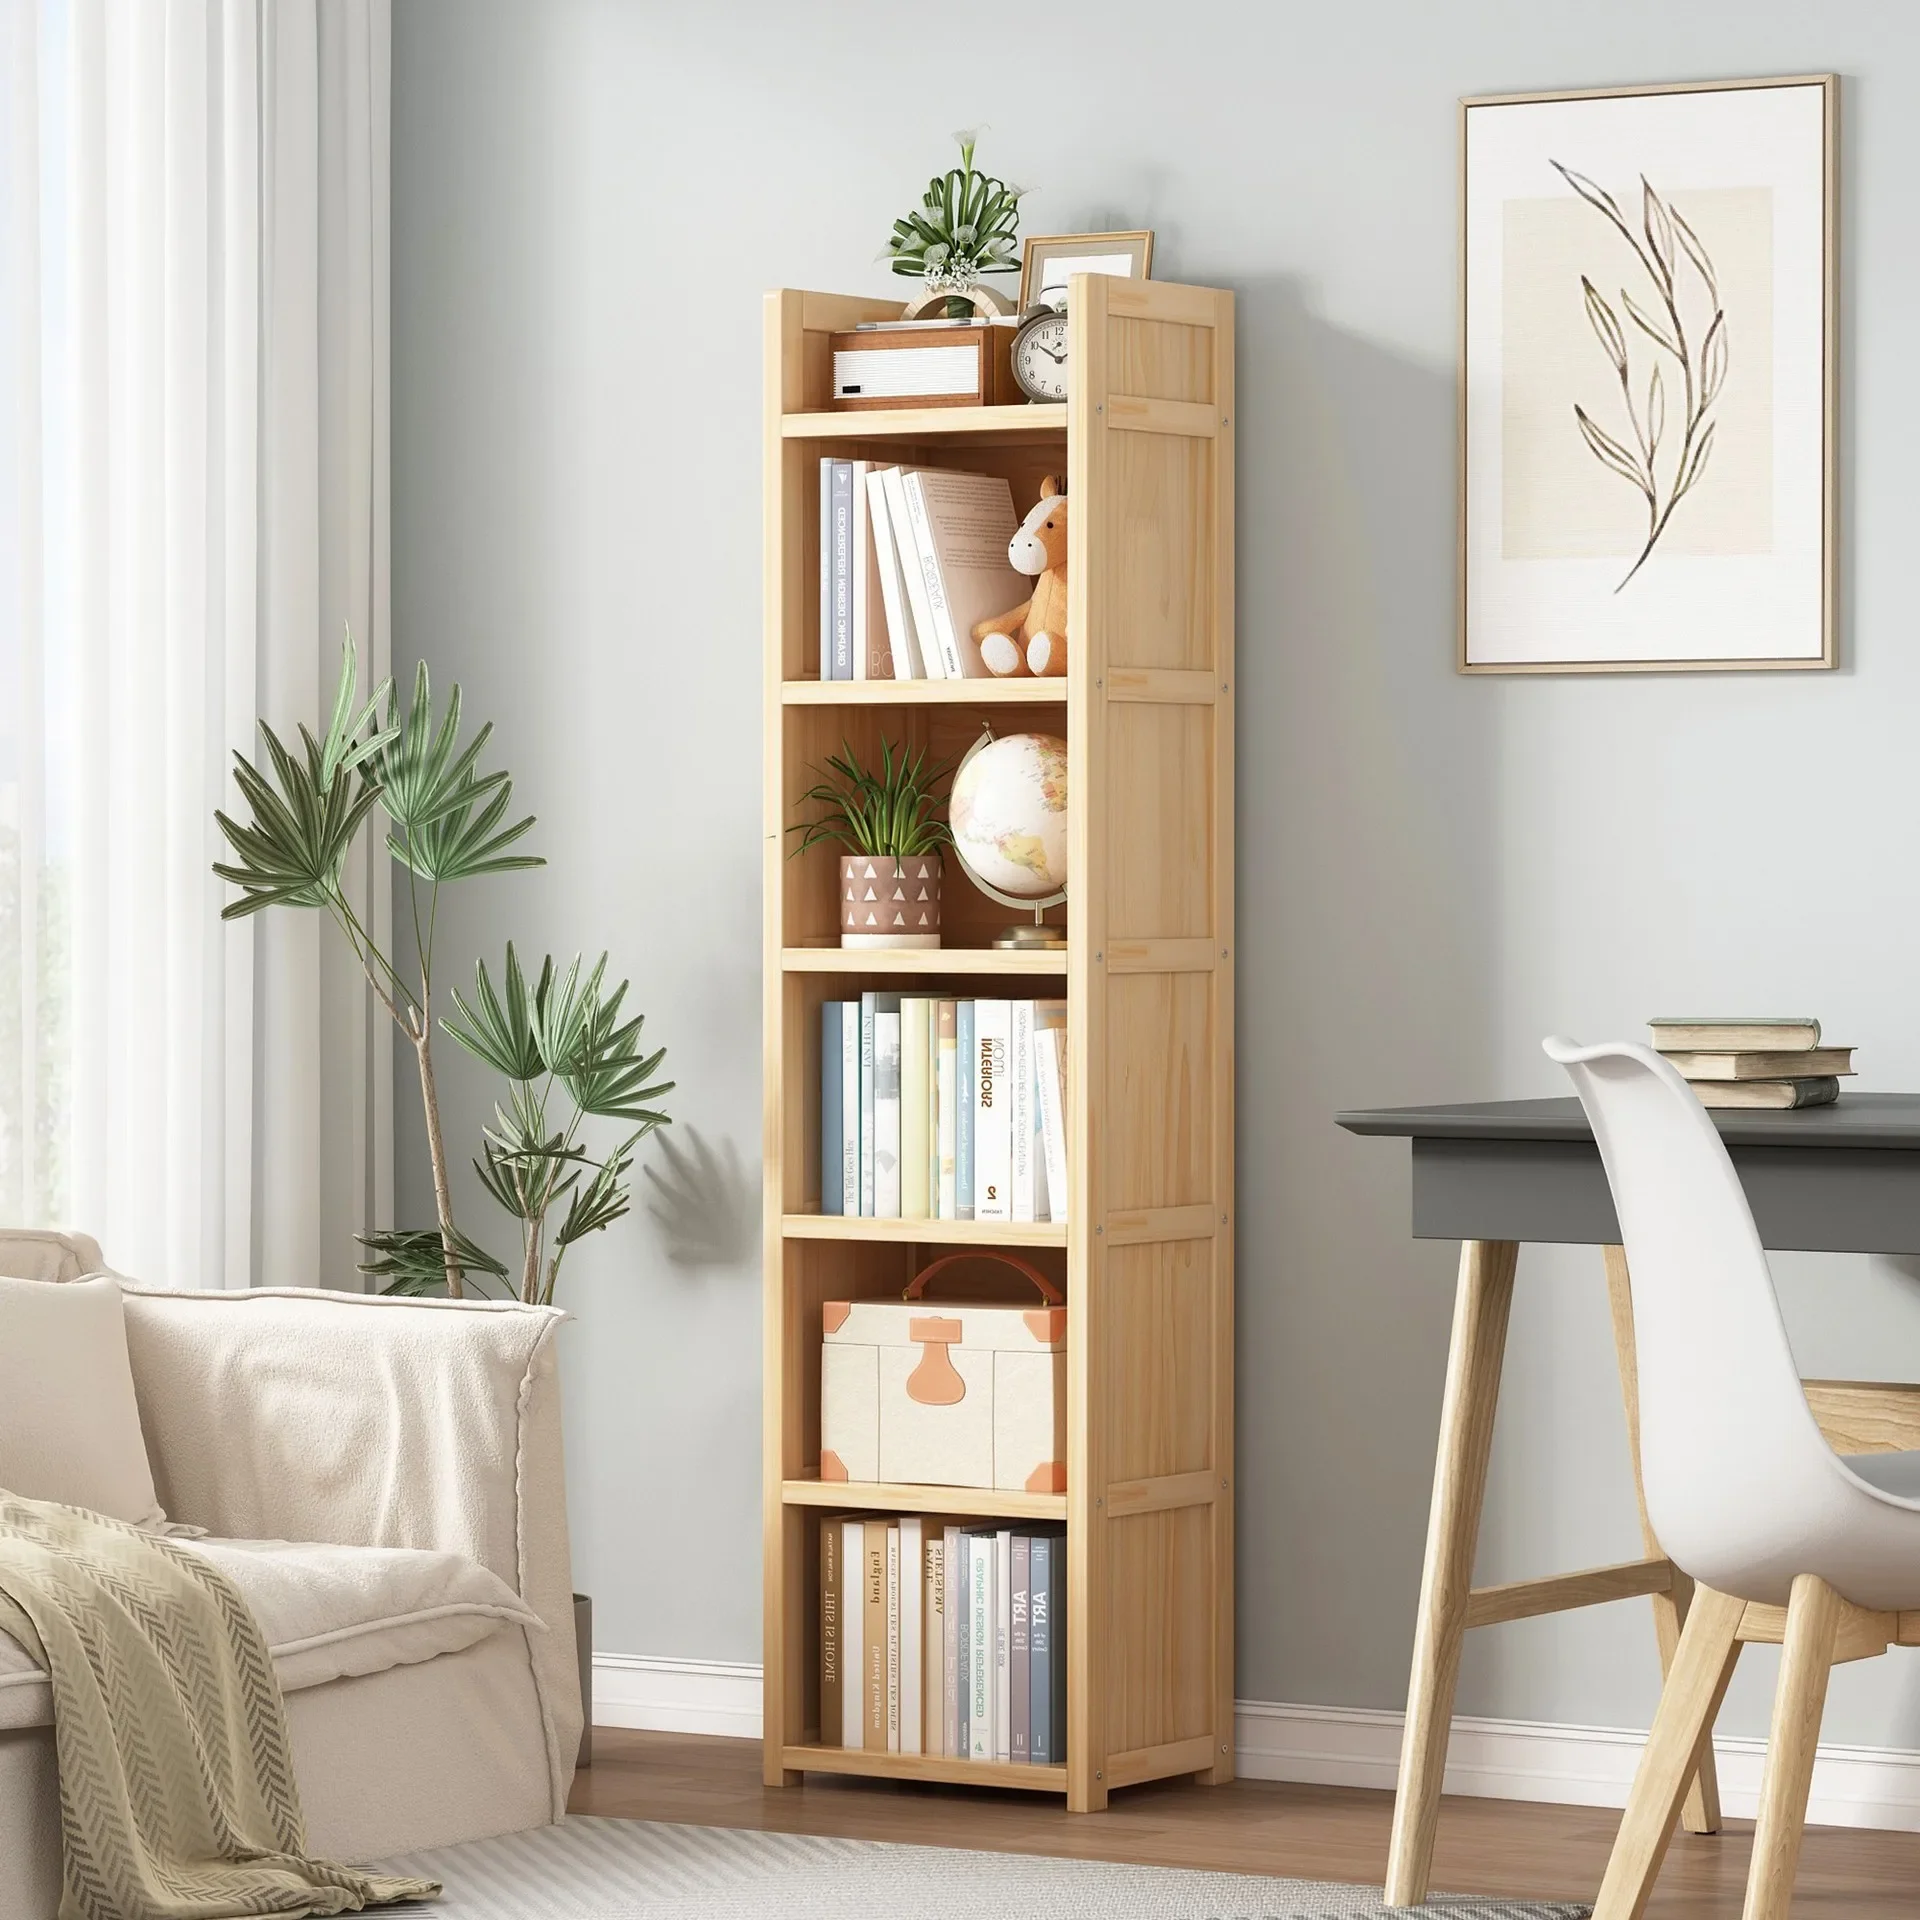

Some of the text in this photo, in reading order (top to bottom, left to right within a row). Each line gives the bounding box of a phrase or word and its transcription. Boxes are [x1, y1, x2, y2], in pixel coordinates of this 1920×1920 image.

[1042, 331, 1049, 340] 11
[1055, 327, 1064, 335] 12
[1030, 342, 1039, 350] 10
[1025, 356, 1031, 365] 9
[1029, 371, 1035, 380] 8
[1041, 381, 1047, 389] 7
[1055, 385, 1062, 394] 6
